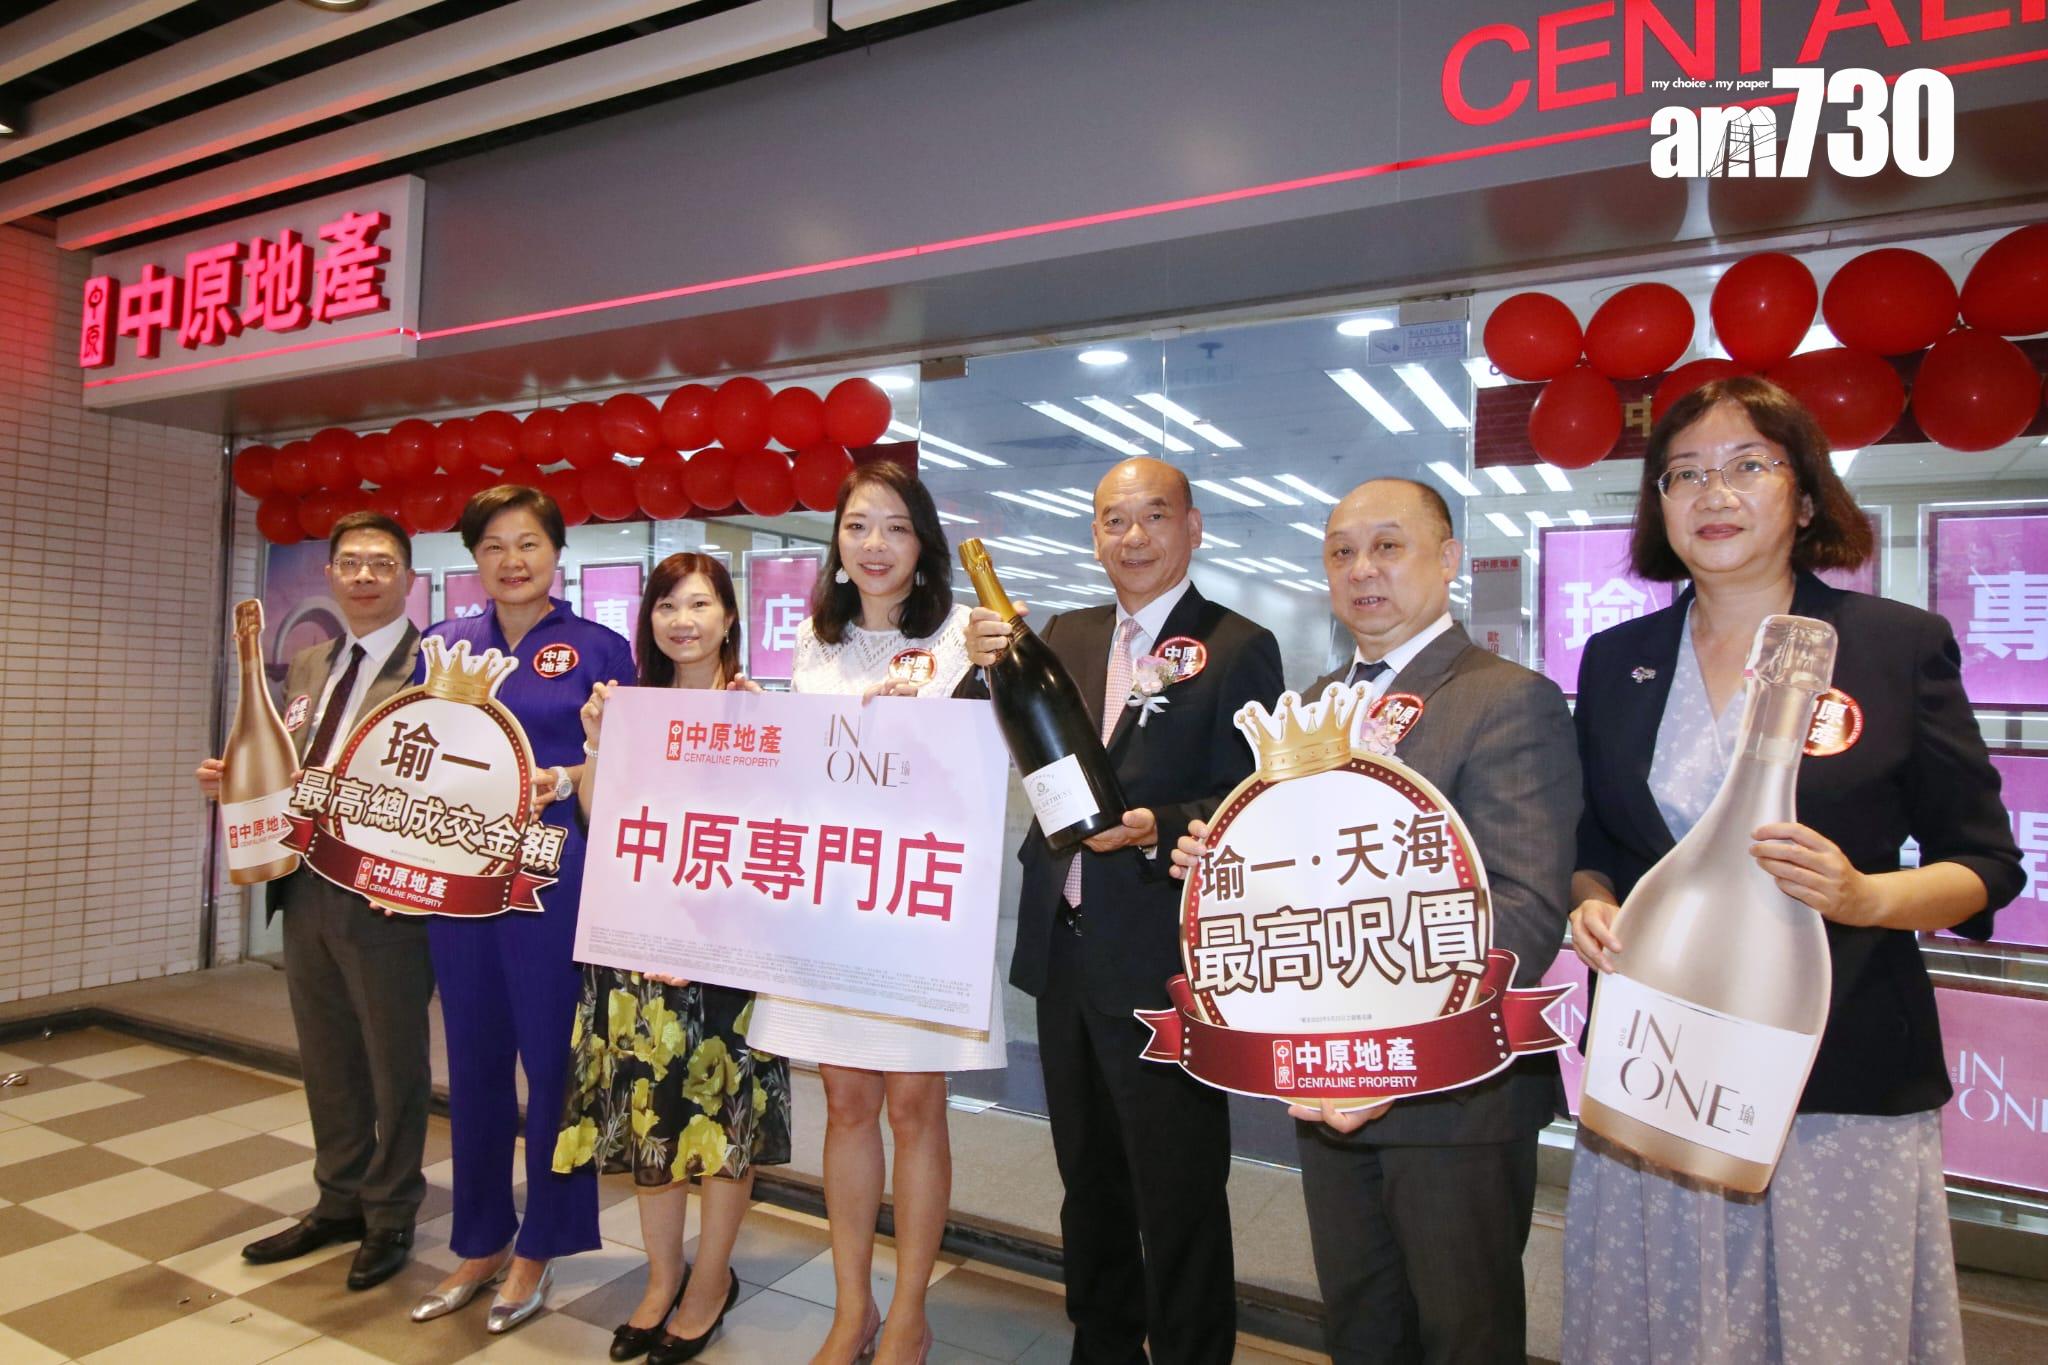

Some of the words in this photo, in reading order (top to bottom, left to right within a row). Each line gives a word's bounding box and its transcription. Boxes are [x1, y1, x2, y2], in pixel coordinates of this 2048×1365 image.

[1442, 0, 2048, 126] CENTA
[118, 211, 391, 358] 中原地產
[1812, 699, 1849, 722] 原
[381, 720, 491, 782] 瑜一
[686, 722, 782, 753] 中原地產
[829, 714, 861, 748] IN
[684, 752, 732, 765] CENTALINE
[733, 756, 781, 768] PROPERTY
[827, 750, 899, 787] ONE
[290, 767, 568, 873] 最高總成交金額
[373, 863, 448, 898] 中原地產
[616, 806, 965, 922] 中原專門店
[369, 883, 405, 899] CENTALINE
[406, 892, 443, 908] PROPERTY
[1194, 889, 1488, 993] 最高呎價
[1295, 1037, 1417, 1073] 中原地產
[1627, 1009, 1682, 1064] IN
[1298, 1076, 1356, 1089] CENTALINE
[1358, 1076, 1417, 1088] PROPERTY
[1959, 1050, 2004, 1090] IN
[1620, 1056, 1740, 1133] ONE
[1958, 1087, 2048, 1133] ON
